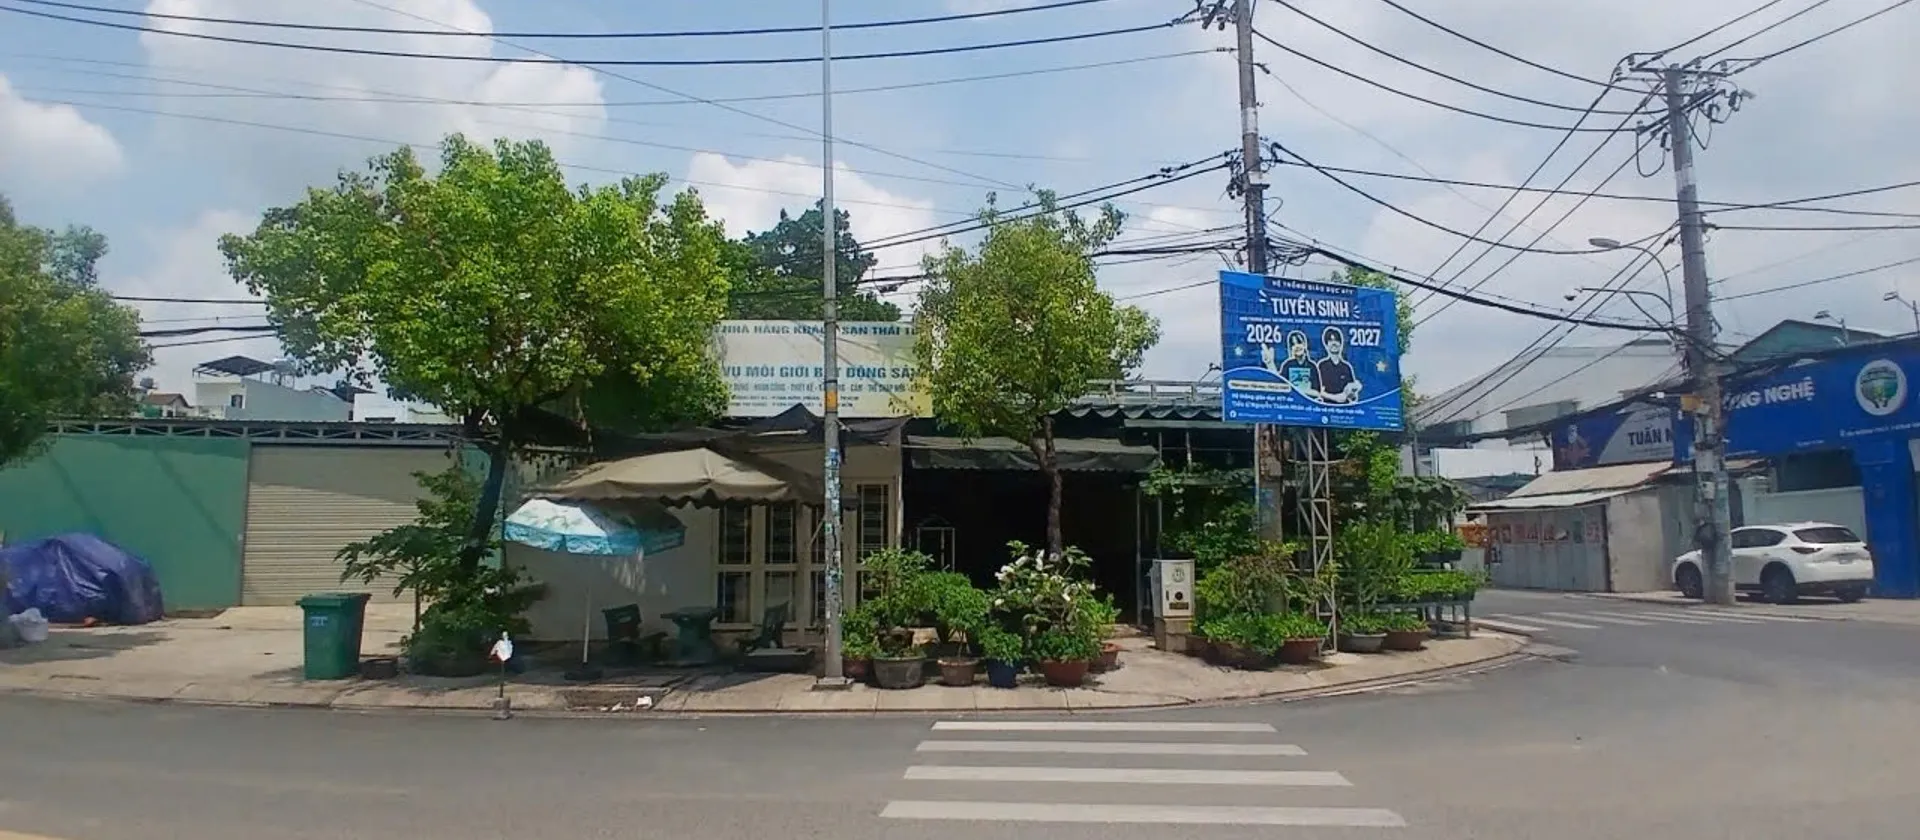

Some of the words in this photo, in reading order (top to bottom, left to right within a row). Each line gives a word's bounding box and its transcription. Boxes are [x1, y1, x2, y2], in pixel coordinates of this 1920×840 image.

[1271, 293, 1316, 316] TUYỂN
[1317, 300, 1349, 318] SINH
[1246, 324, 1282, 343] 2026
[1349, 329, 1381, 346] 2027
[746, 363, 775, 378] MÔI
[779, 364, 809, 378] GIỚI
[846, 364, 886, 379] ĐỘNG
[1764, 376, 1816, 404] NGHỆ
[1628, 424, 1661, 445] TUẤN
